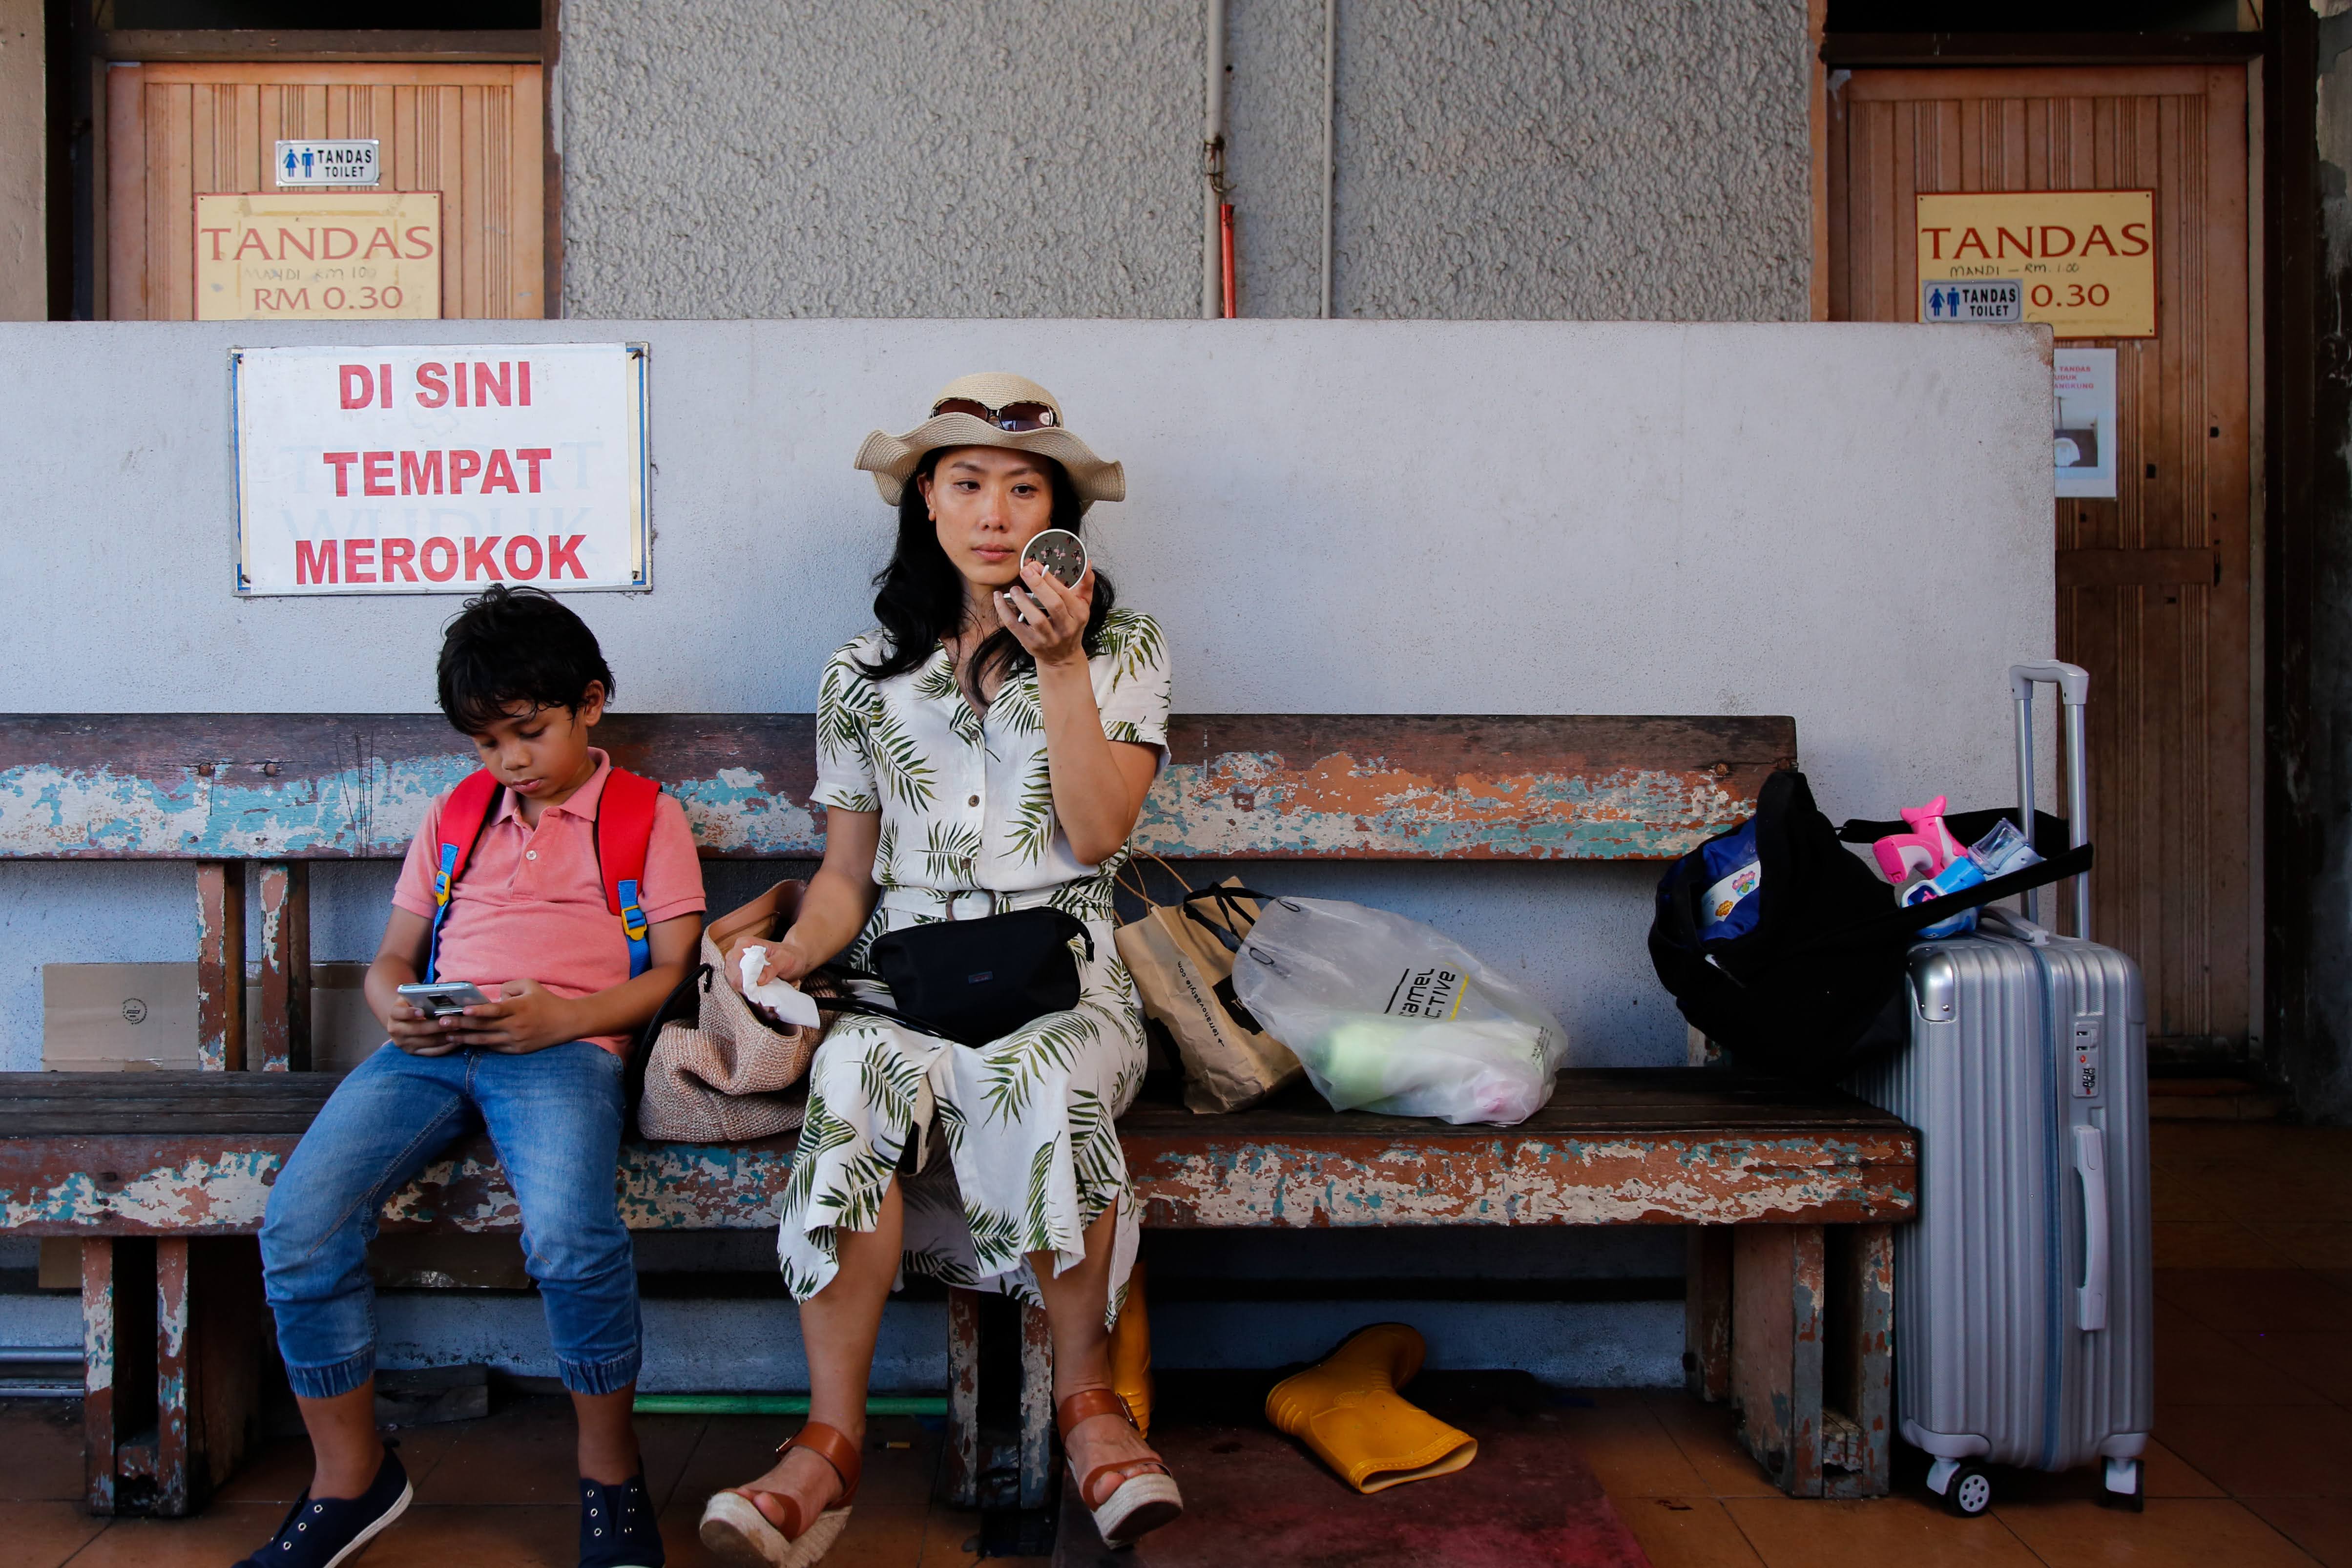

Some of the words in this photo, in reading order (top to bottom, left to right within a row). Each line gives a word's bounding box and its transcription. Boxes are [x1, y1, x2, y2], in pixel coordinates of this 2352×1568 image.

[317, 149, 372, 164] TANDAS
[325, 166, 364, 177] TOILET
[200, 226, 433, 260] TANDAS
[1921, 223, 2149, 259] TANDAS
[1950, 265, 2000, 277] MANDI
[254, 287, 311, 311] RM
[323, 286, 404, 310] 0.30
[1962, 288, 2017, 303] TANDAS
[2031, 283, 2110, 308] 0.30
[1970, 305, 2009, 316] TOILET
[339, 363, 393, 410] DI
[416, 361, 531, 409] SINI
[323, 448, 552, 497] TEMPAT
[295, 534, 588, 585] MEROKOK
[1177, 961, 1219, 1037] terranovastyle.com
[1398, 968, 1435, 1017] amel
